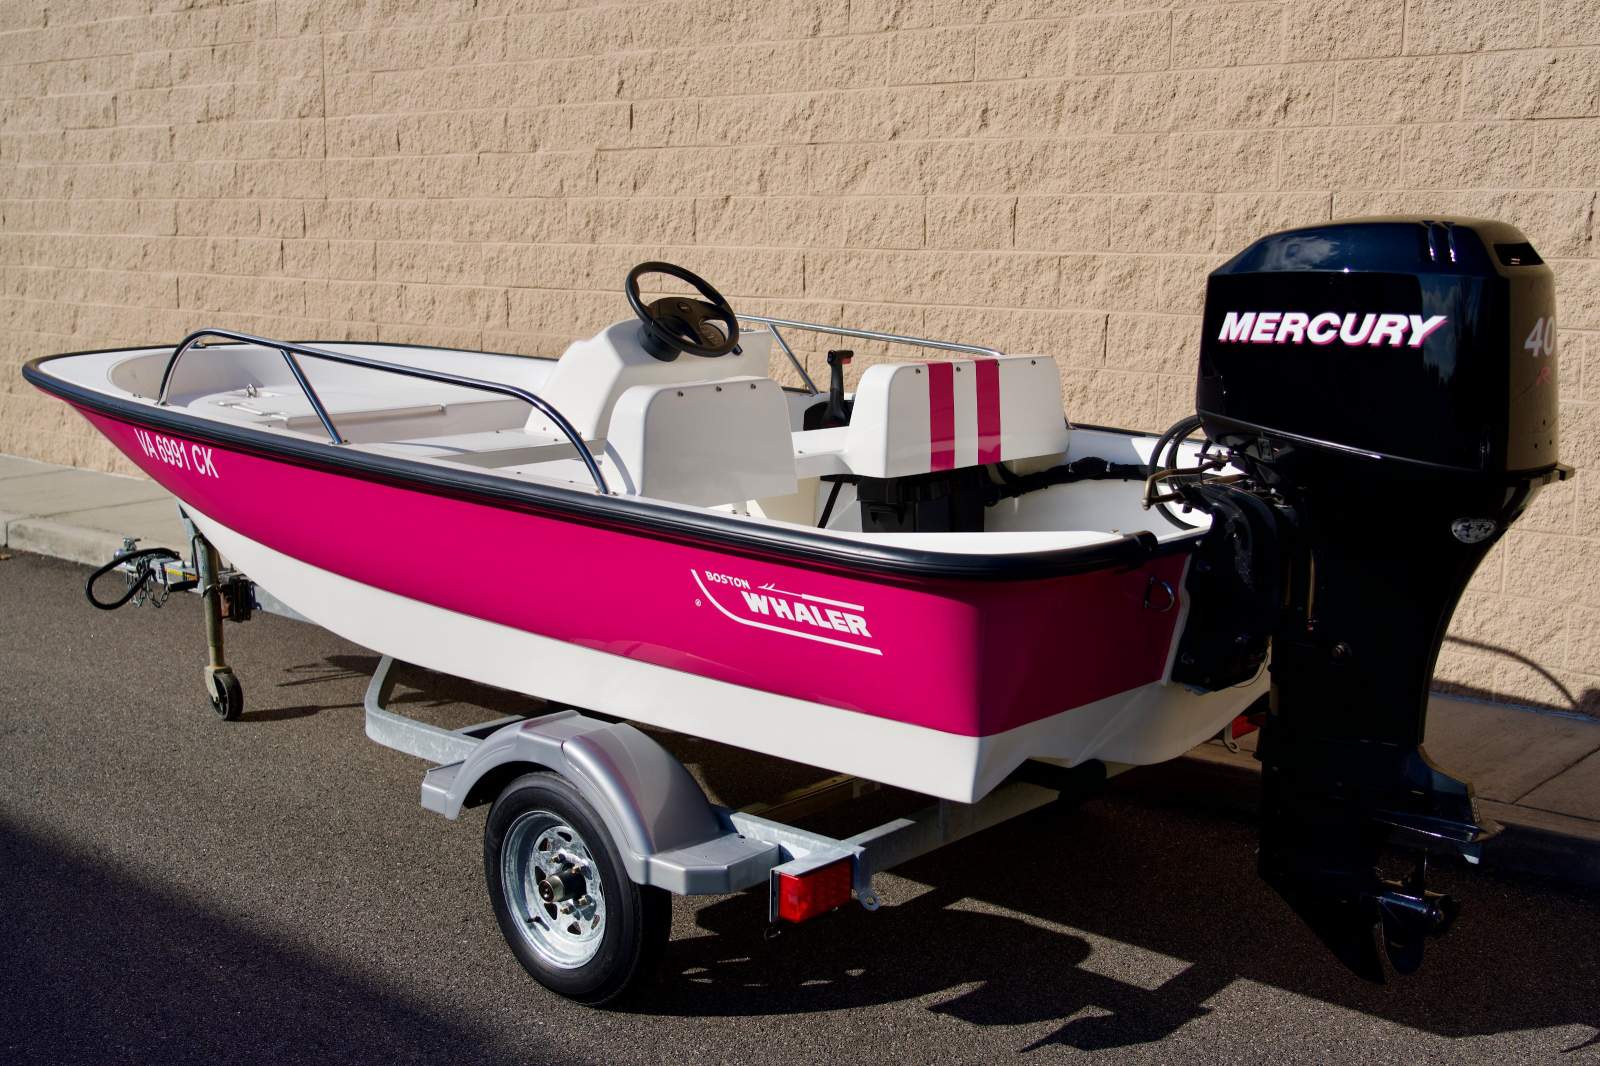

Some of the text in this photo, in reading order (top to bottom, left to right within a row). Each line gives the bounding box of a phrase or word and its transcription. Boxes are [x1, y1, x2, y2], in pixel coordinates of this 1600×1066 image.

[1217, 312, 1448, 347] MERCURY
[1524, 316, 1555, 358] 40
[134, 428, 220, 479] VA 6991 CK
[705, 570, 751, 590] BOSTON
[741, 590, 872, 638] WHALER
